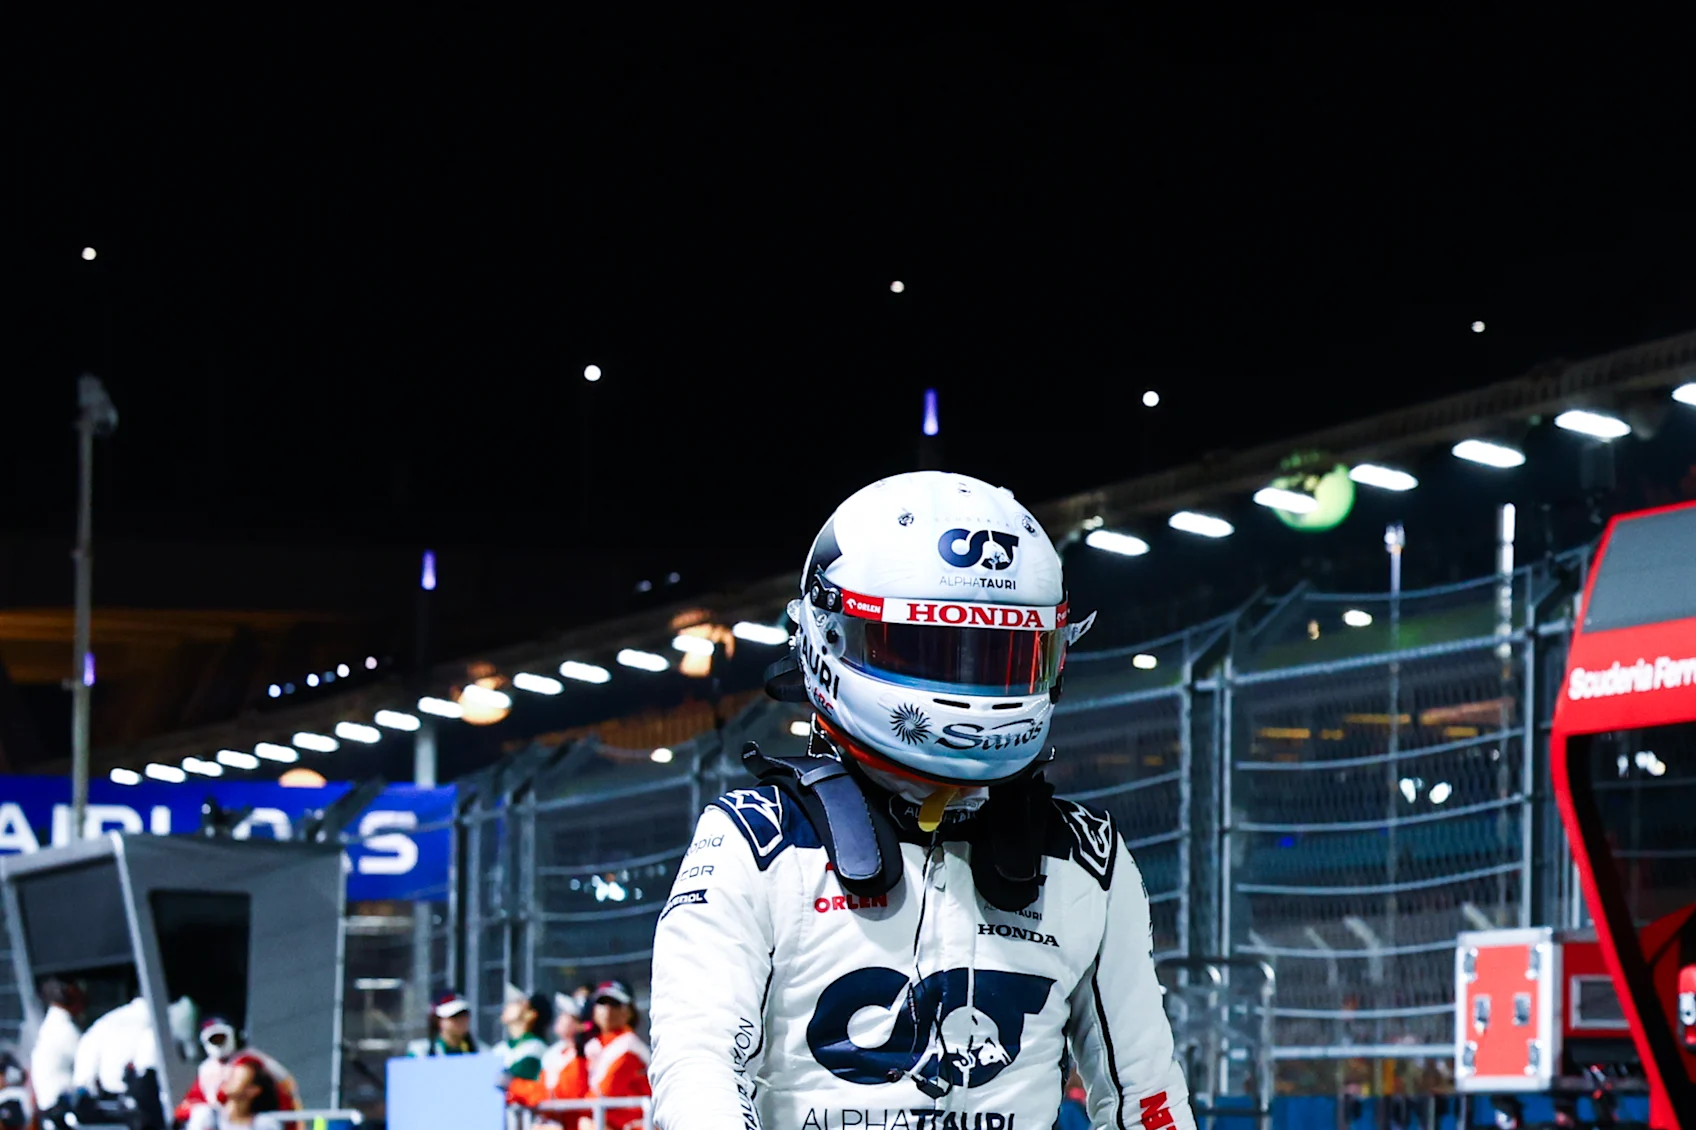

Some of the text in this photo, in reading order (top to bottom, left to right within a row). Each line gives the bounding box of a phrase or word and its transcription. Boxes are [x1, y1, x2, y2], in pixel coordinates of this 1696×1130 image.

[939, 576, 1017, 590] ALPHATAURI
[857, 603, 882, 615] ORLEN
[906, 602, 1045, 629] HONDA
[1568, 658, 1653, 701] Scuderia
[977, 923, 1061, 948] HONDA
